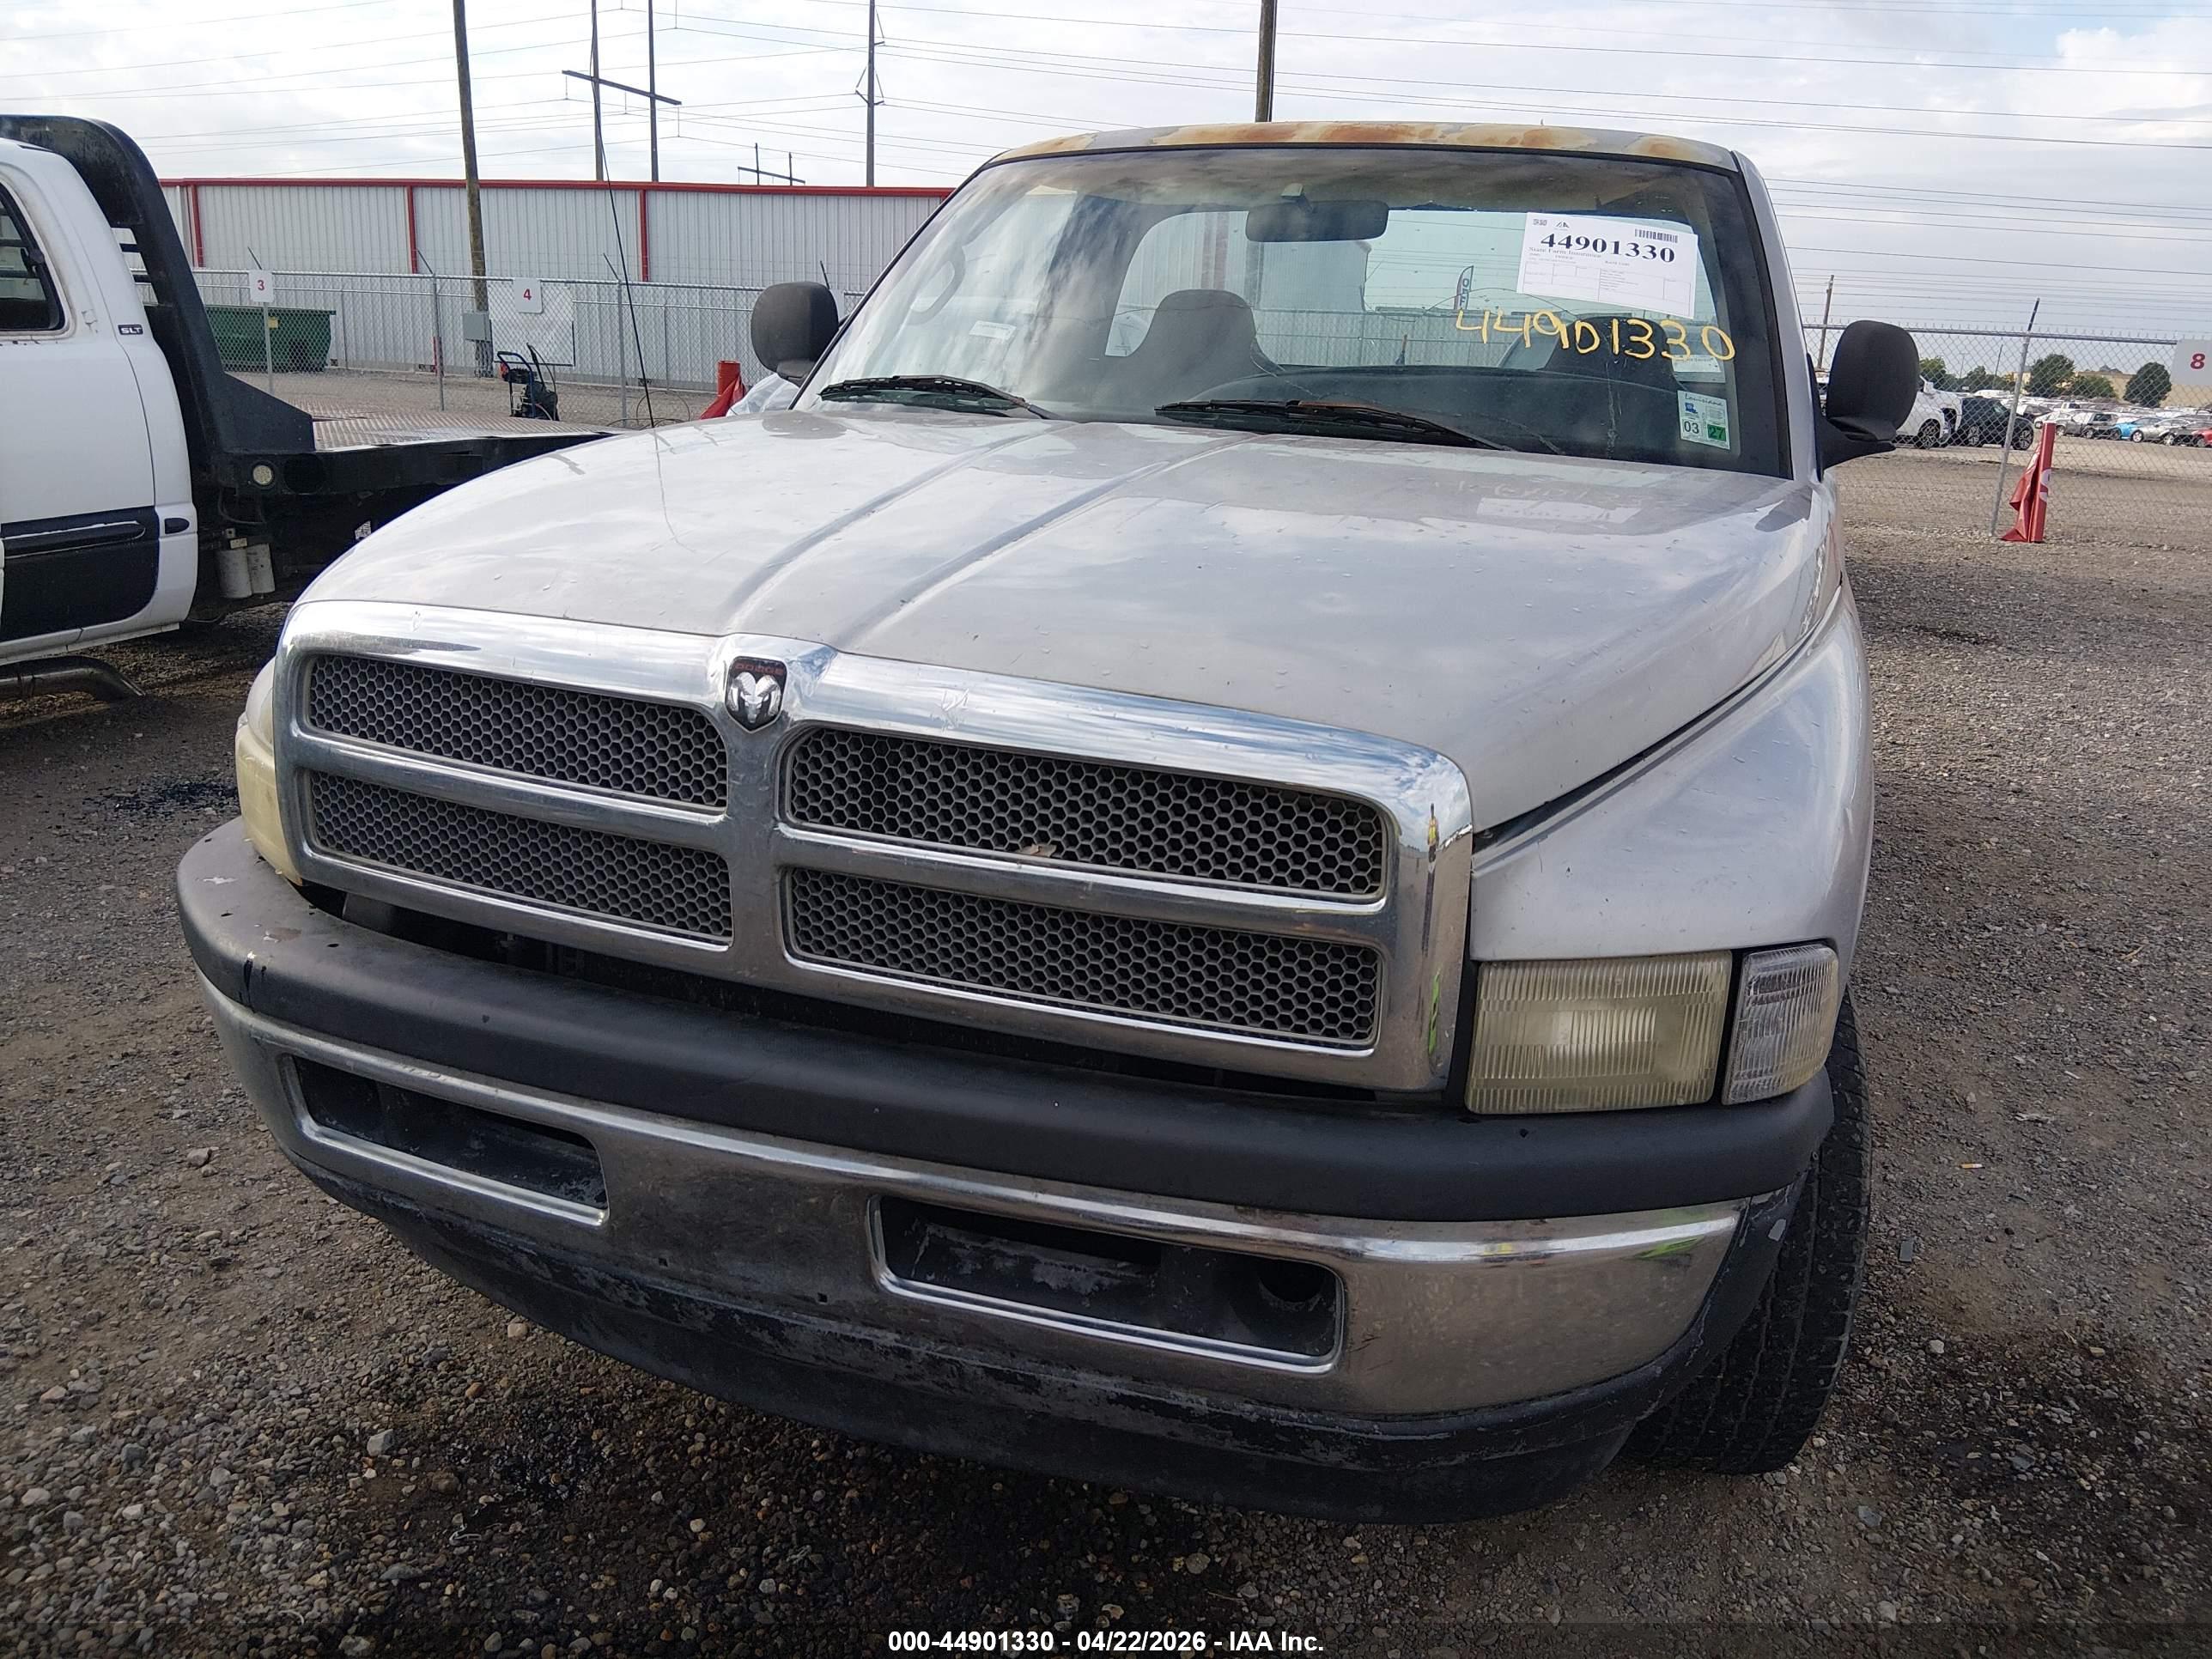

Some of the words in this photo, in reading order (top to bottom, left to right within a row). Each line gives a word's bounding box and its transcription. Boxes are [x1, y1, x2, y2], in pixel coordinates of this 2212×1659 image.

[1540, 233, 1675, 263] 44901330
[258, 279, 265, 290] 3
[523, 289, 532, 301] 4
[1455, 308, 1735, 361] 44901330
[2190, 353, 2206, 370] 8
[1684, 421, 1699, 434] 03
[1709, 426, 1724, 440] 27
